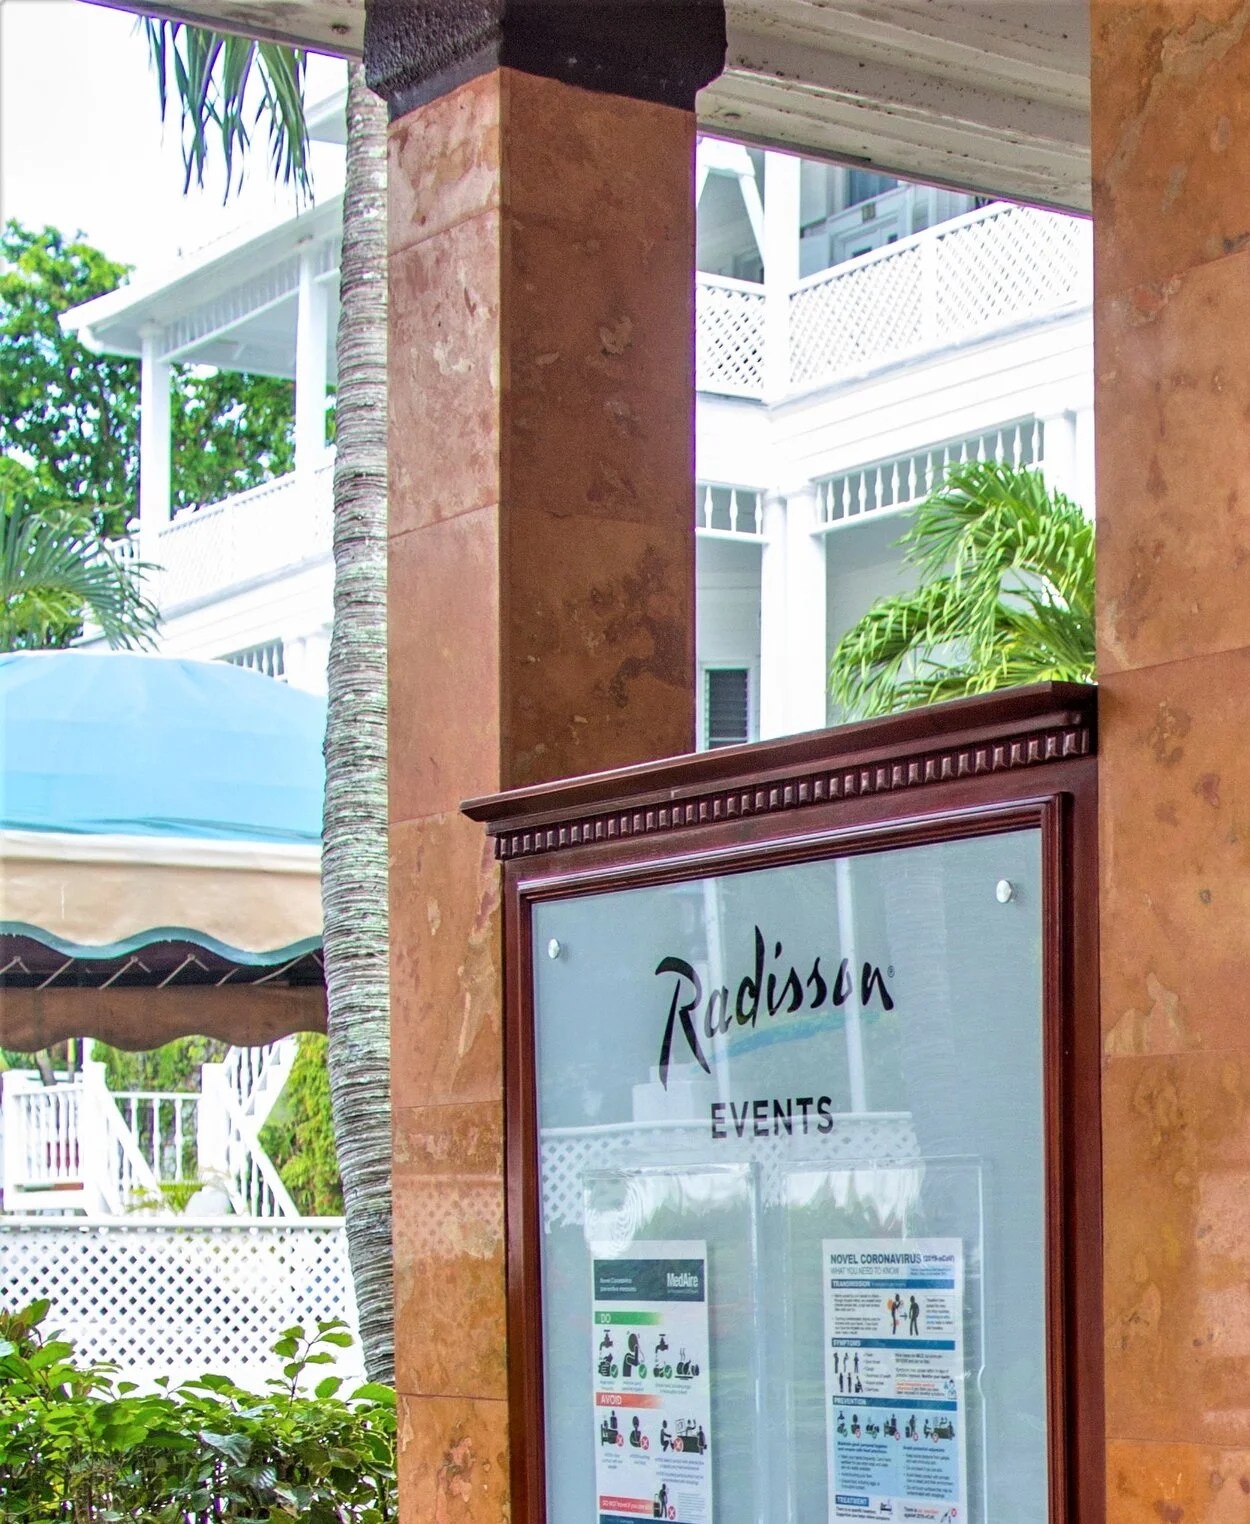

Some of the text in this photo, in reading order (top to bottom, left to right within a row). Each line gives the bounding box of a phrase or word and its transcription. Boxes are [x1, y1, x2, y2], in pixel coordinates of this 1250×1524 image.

[710, 1096, 833, 1139] EVENTS
[830, 1254, 858, 1264] NOVEL
[860, 1253, 921, 1264] CORONAVIRUS
[830, 1266, 899, 1274] WHAT YOU NEED TO KNOW
[667, 1272, 698, 1288] MedAire
[600, 1313, 611, 1324] DO
[600, 1394, 622, 1406] AVOID
[838, 1496, 868, 1505] TREATMENT
